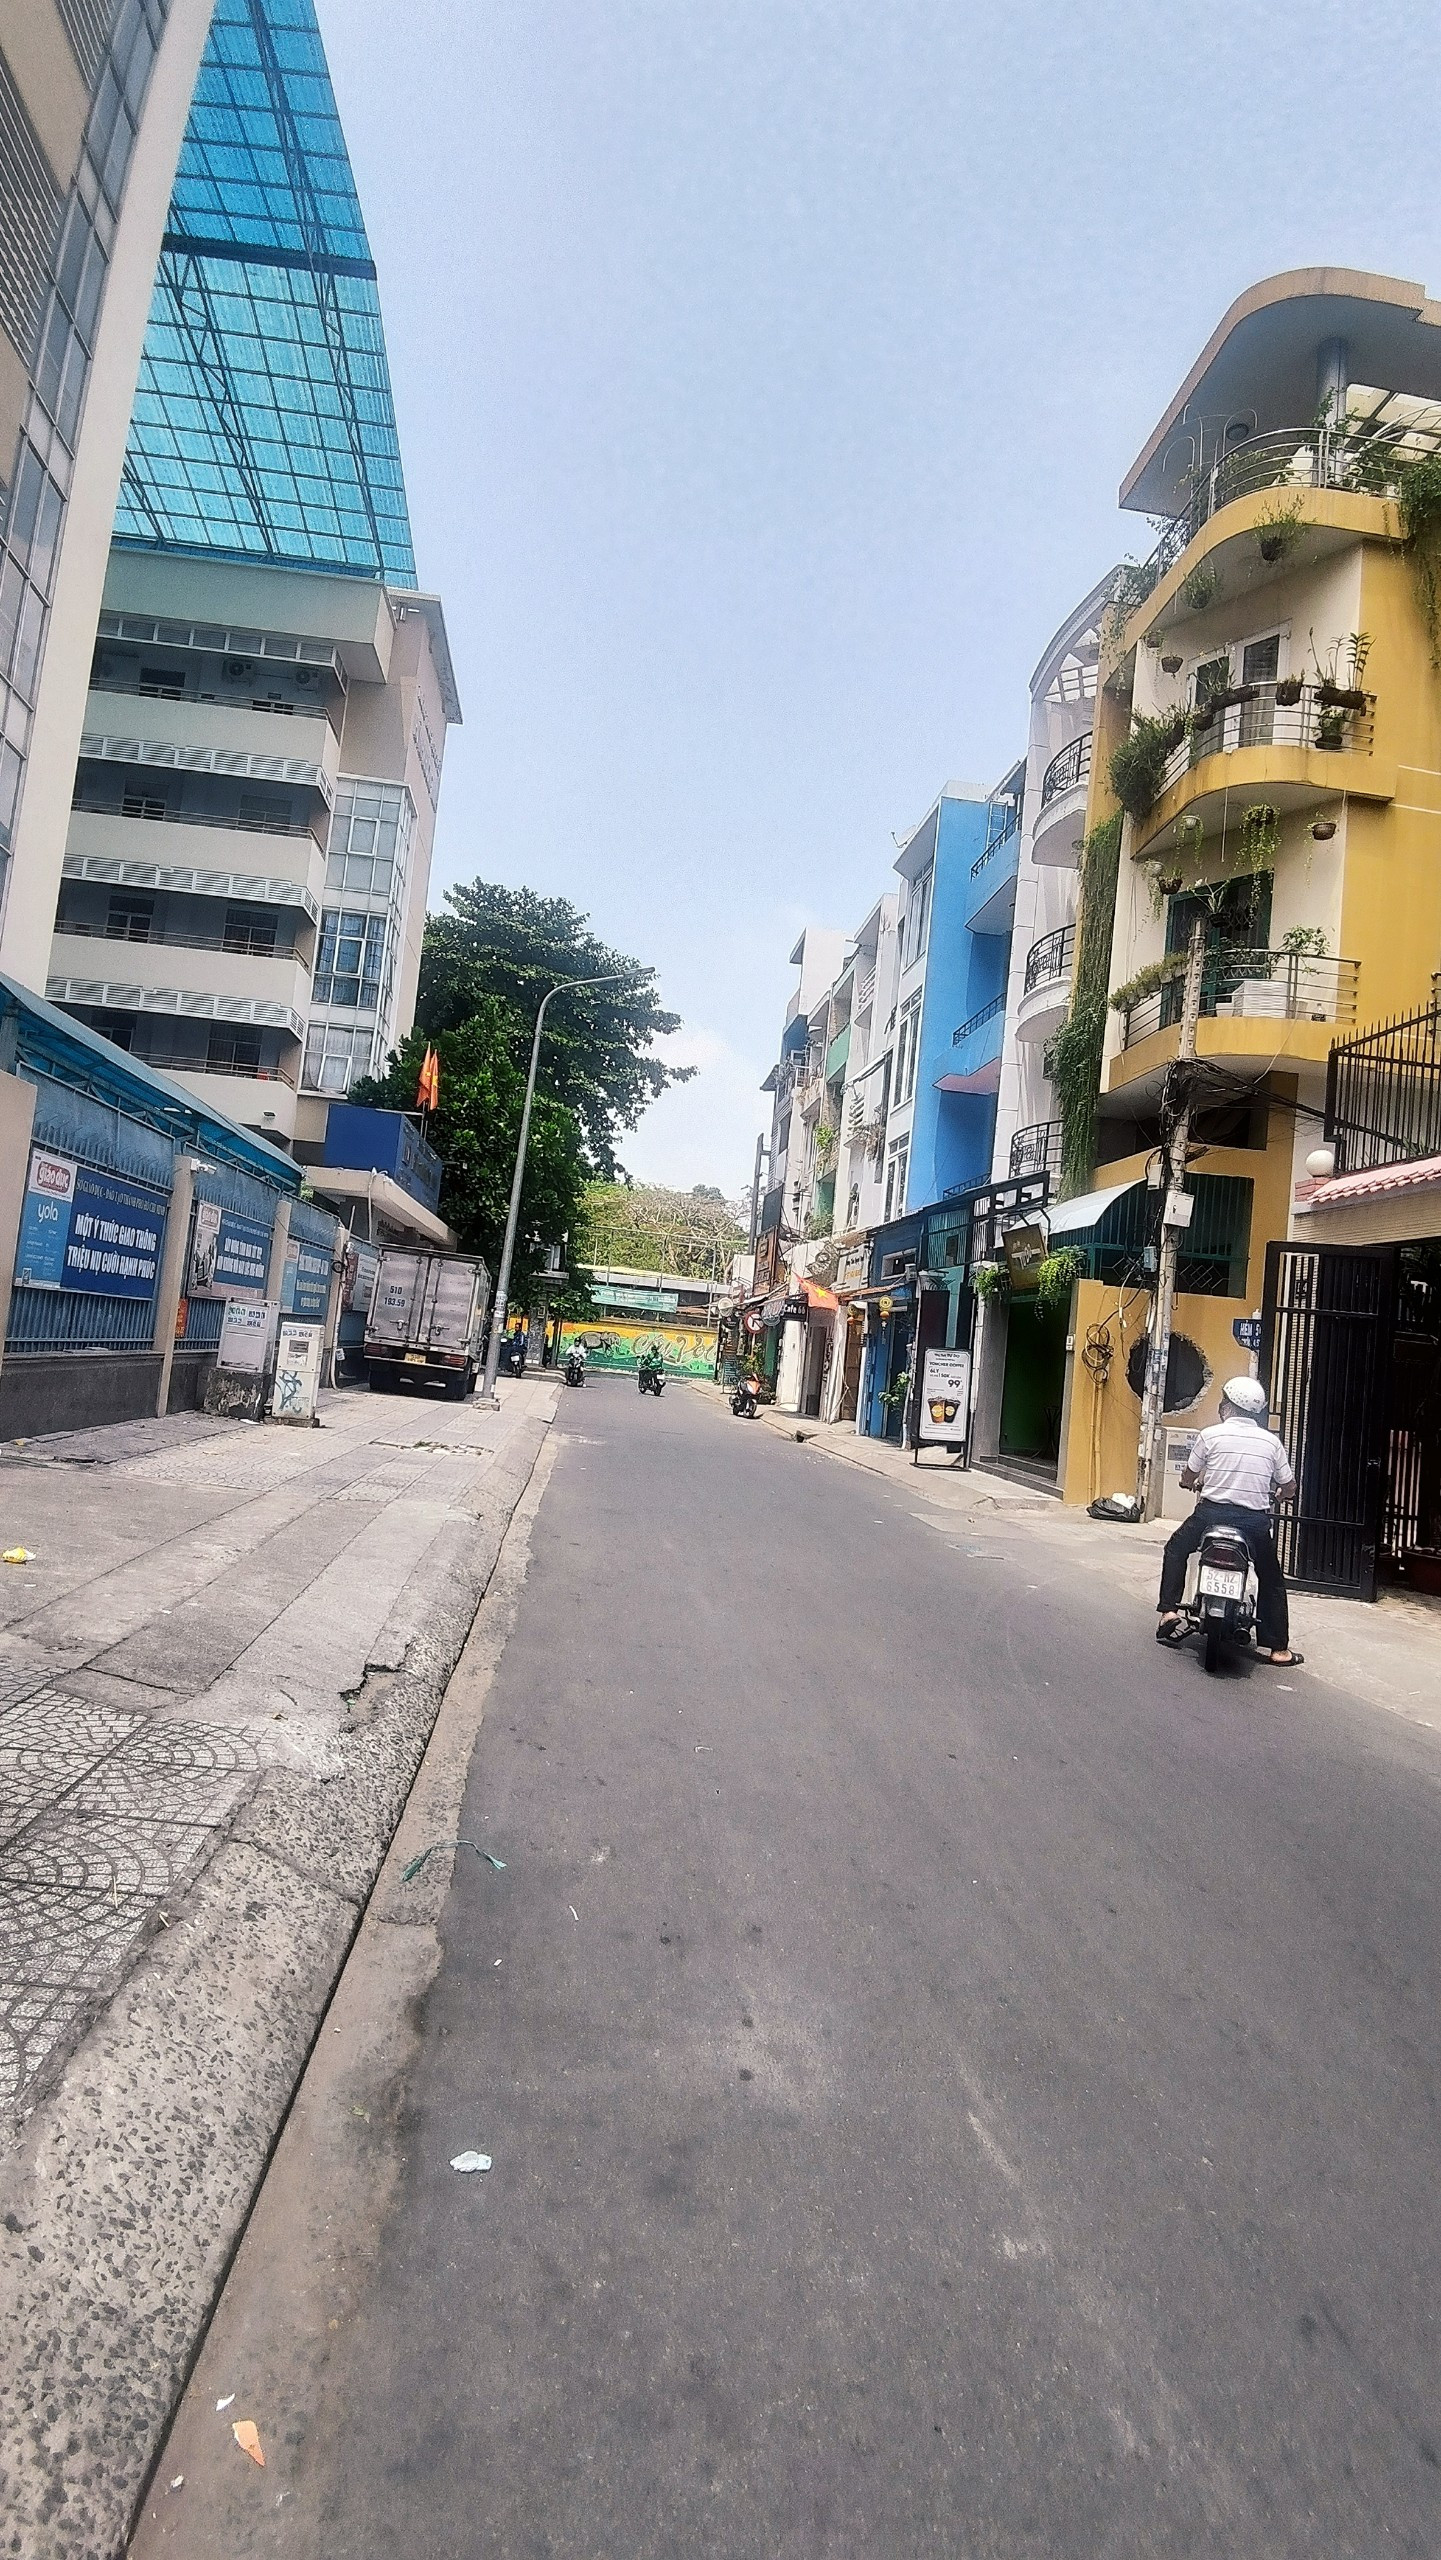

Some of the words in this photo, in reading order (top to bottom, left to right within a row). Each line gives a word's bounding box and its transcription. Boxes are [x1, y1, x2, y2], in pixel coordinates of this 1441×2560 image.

[38, 1201, 58, 1223] yola
[75, 1212, 93, 1242] MỘT
[93, 1215, 100, 1239] Ý
[99, 1219, 119, 1244] THỨC
[119, 1225, 135, 1247] GIAO
[135, 1228, 157, 1252] THÔNG
[67, 1244, 90, 1273] TRIỆU
[90, 1250, 102, 1276] NỤ
[101, 1250, 120, 1274] CƯỜI
[119, 1255, 138, 1279] HẠNH
[138, 1257, 156, 1280] PHÚC
[1207, 1582, 1234, 1595] 6558
